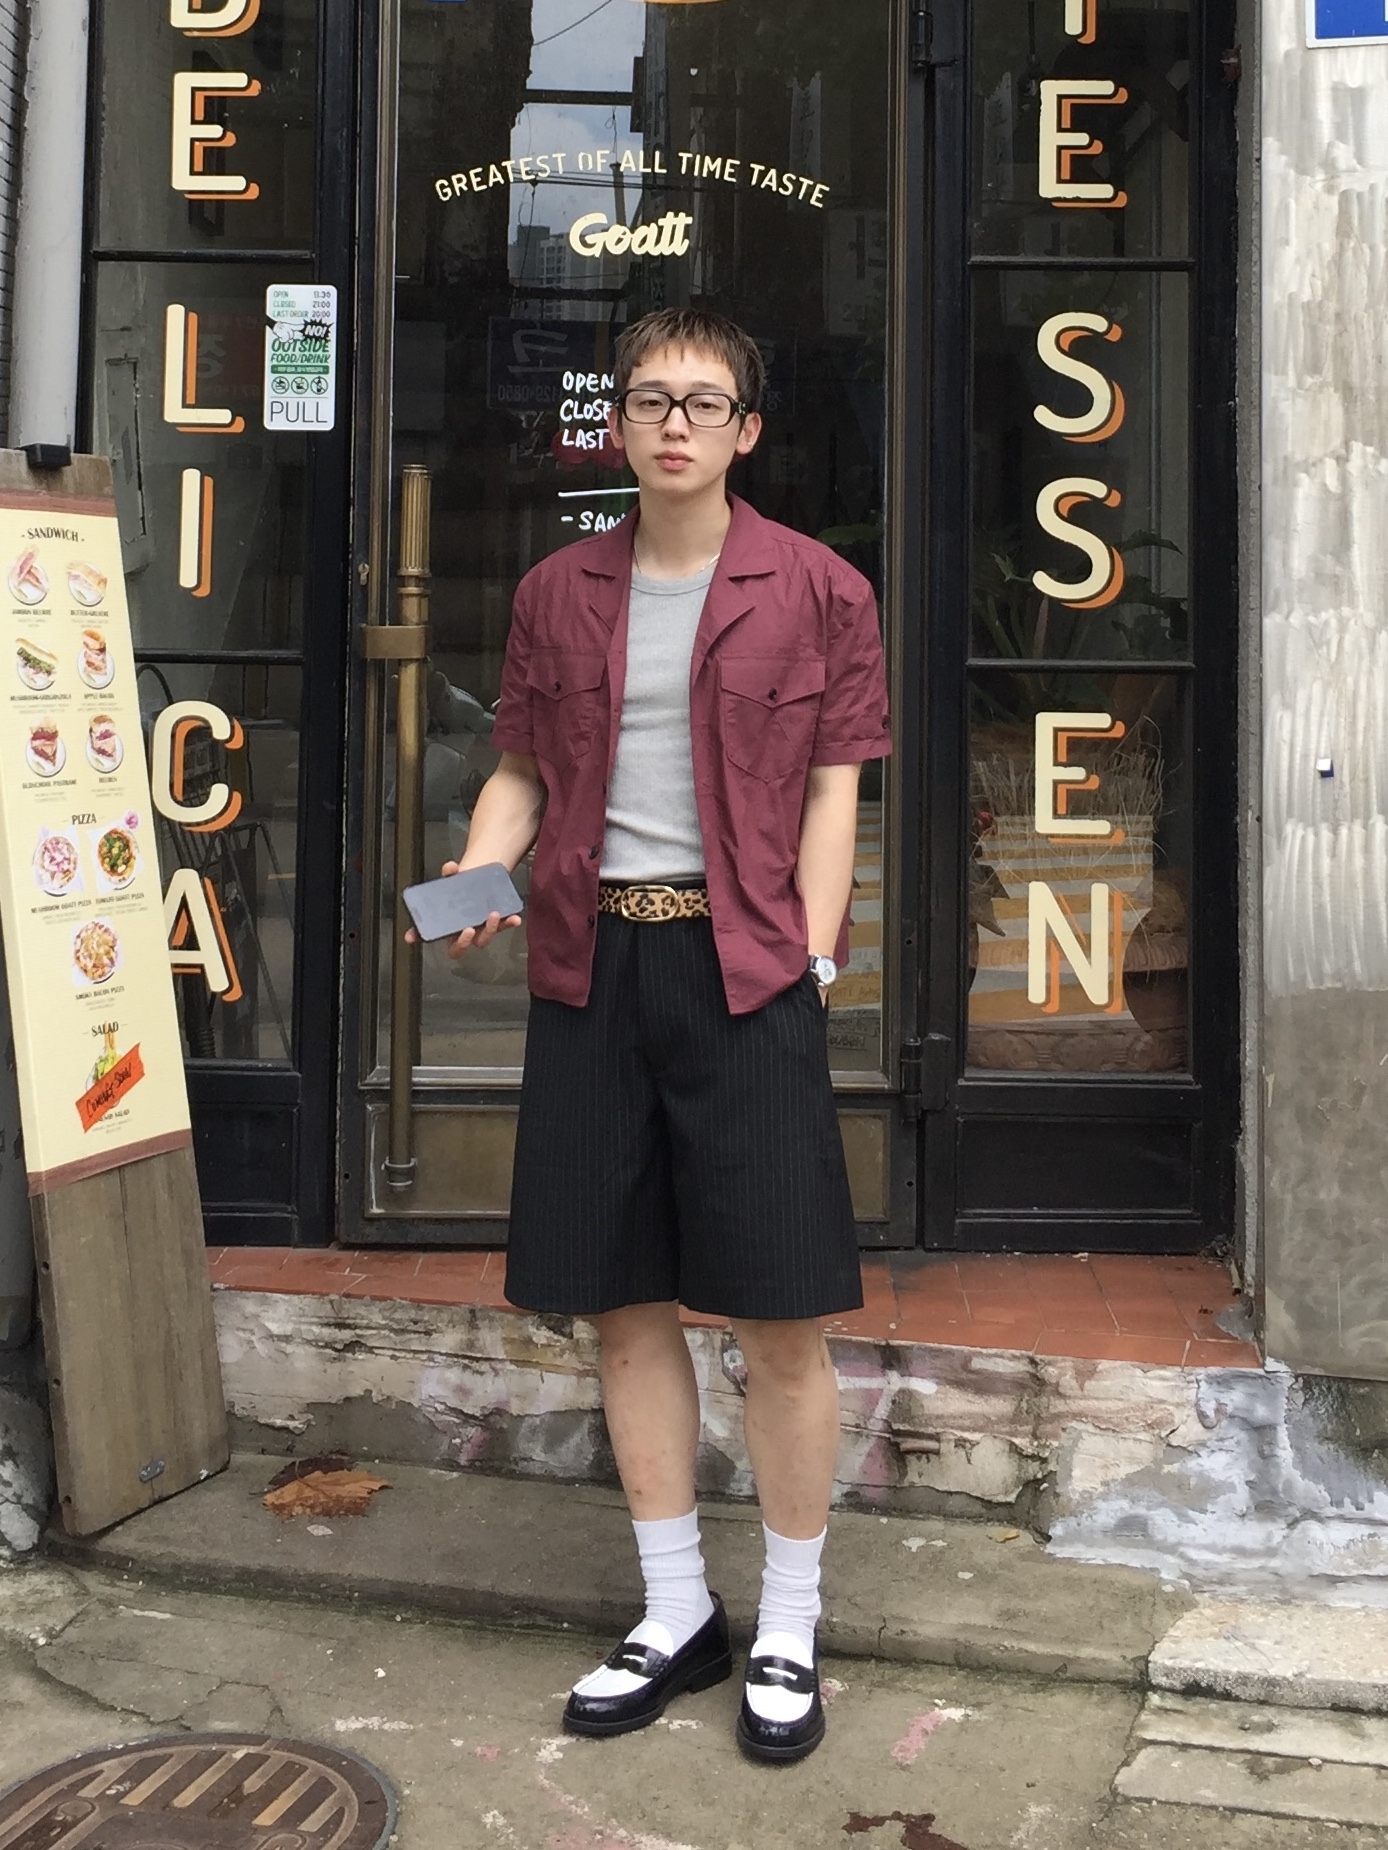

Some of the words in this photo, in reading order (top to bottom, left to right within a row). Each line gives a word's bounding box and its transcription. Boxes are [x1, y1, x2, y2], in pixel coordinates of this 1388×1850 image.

[435, 153, 567, 202] GREATEST
[578, 150, 610, 172] OF
[619, 150, 667, 173] ALL
[678, 152, 740, 183] TIME
[750, 163, 830, 208] TASTE
[569, 211, 693, 258] Goatt
[273, 310, 290, 318] LAST
[290, 310, 309, 318] ORDER
[305, 324, 328, 337] NO!
[271, 338, 329, 353] OUTSIDE
[271, 353, 331, 364] FOOD/DRINK
[562, 371, 614, 393] OPEN
[270, 401, 328, 423] PULL
[561, 428, 610, 450] LAST
[153, 0, 262, 1002] ELICA
[27, 527, 79, 542] SANDWICH
[72, 813, 97, 825] PIZZA
[91, 1021, 119, 1037] SALAD
